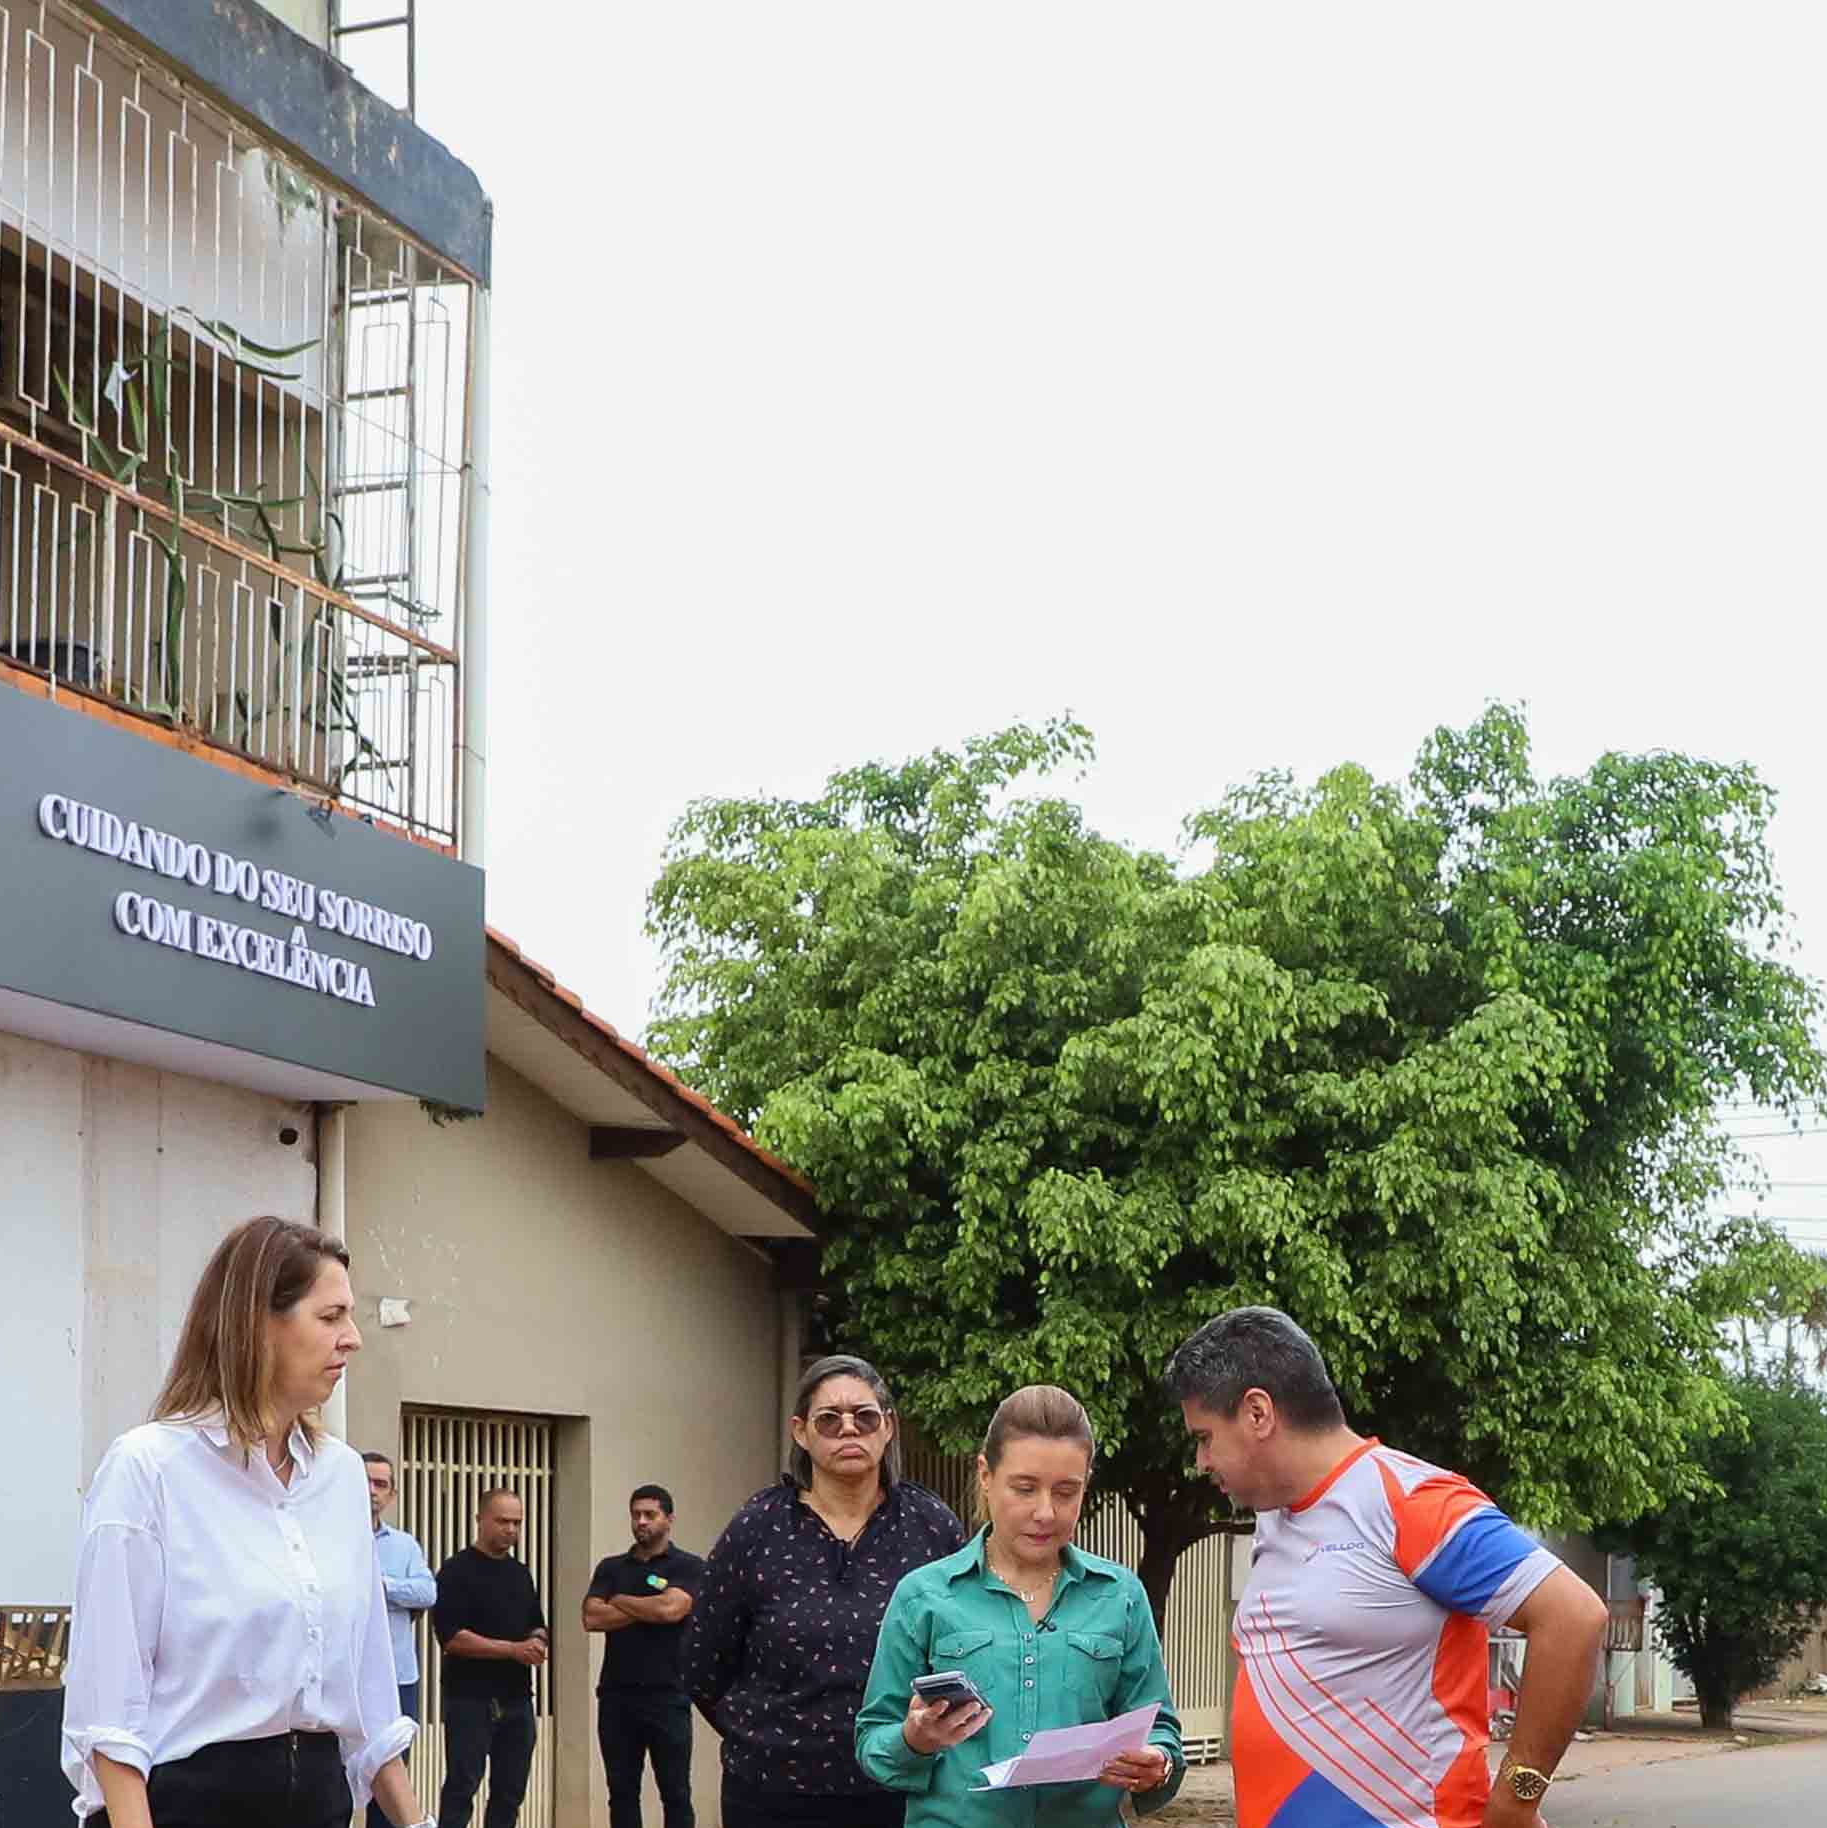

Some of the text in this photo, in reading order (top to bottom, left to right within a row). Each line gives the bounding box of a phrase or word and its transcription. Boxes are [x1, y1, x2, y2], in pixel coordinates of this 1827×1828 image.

[39, 793, 433, 961] CUIDANDO DO SEU SORRISO
[115, 891, 377, 1007] COM EXCELÊNCIA
